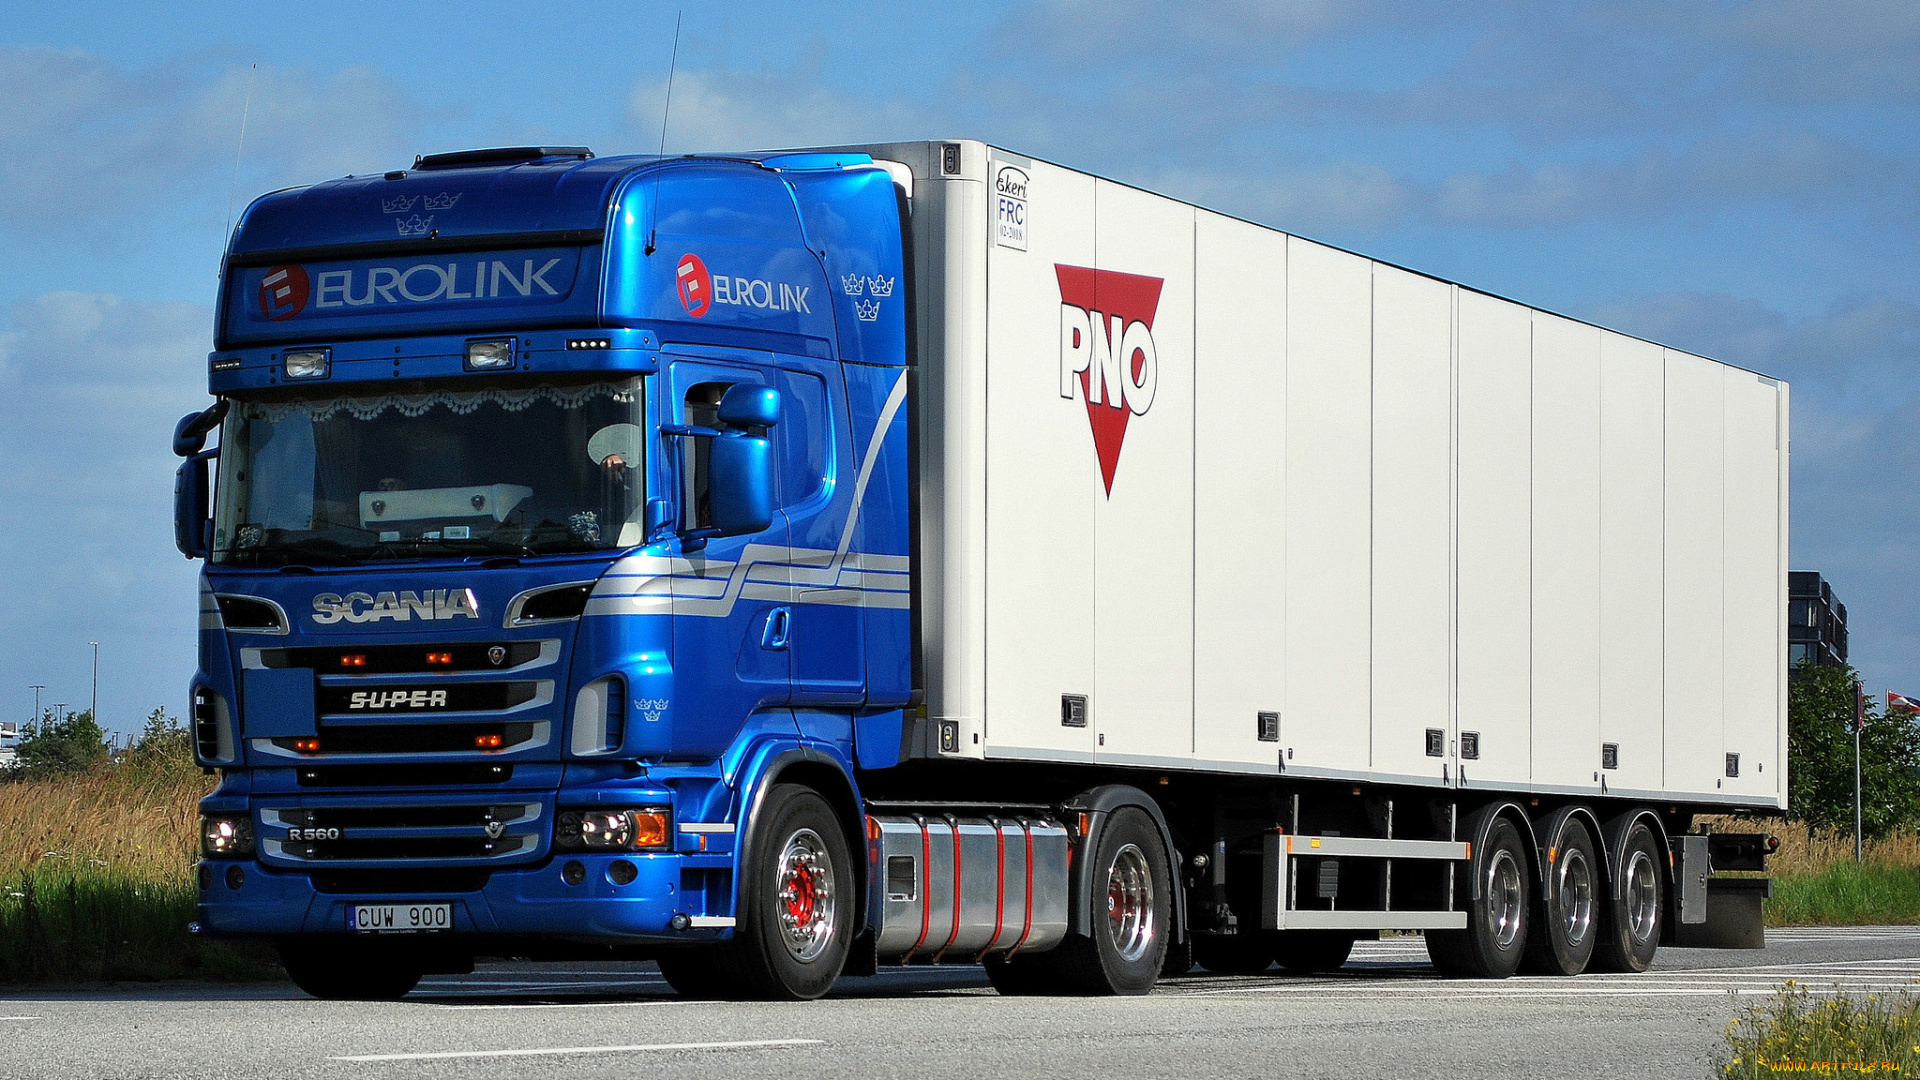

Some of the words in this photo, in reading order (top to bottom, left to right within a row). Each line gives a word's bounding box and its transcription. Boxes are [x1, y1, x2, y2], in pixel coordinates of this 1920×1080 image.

[1000, 198, 1023, 225] FRC
[1000, 225, 1023, 241] 02-2018
[316, 258, 561, 308] EUROLINK
[713, 274, 811, 314] EUROLINK
[1060, 301, 1158, 416] PNO
[311, 587, 479, 624] SCANIA
[349, 690, 447, 709] SUPER
[290, 829, 301, 840] R
[304, 828, 339, 840] 560
[358, 907, 394, 927] CUW
[409, 907, 445, 926] 900
